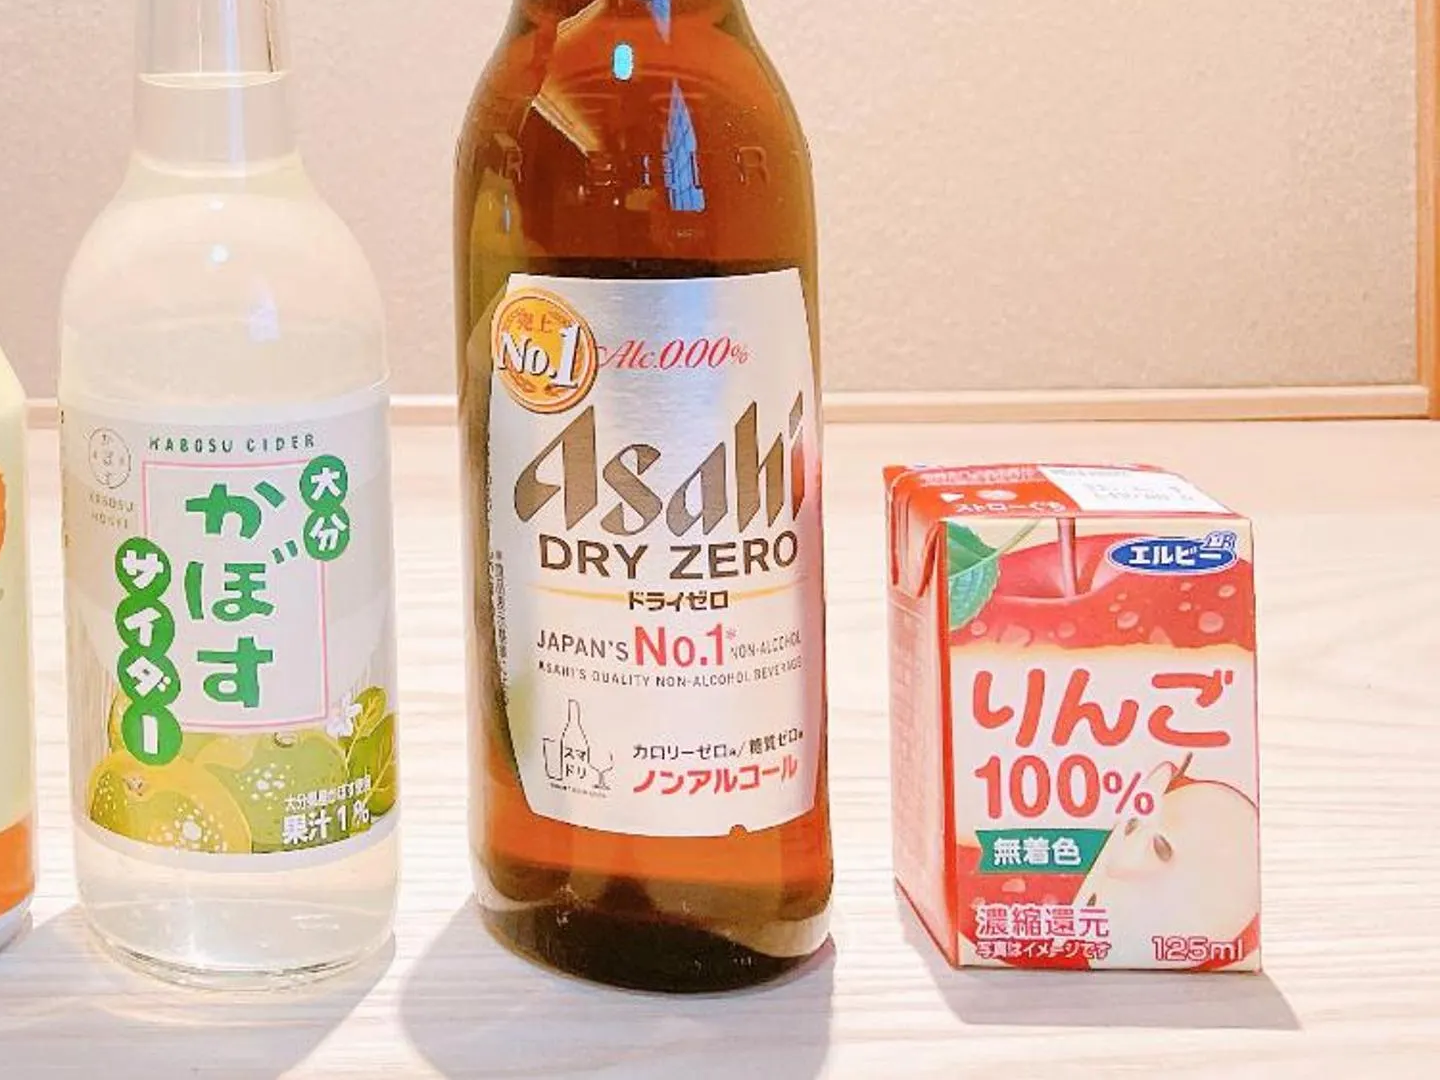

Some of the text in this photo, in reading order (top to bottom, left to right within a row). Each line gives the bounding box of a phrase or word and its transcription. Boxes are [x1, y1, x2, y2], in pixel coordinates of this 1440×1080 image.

[497, 322, 580, 389] No.1
[149, 433, 315, 453] KABOSU CIDER
[514, 391, 805, 537] Asahi
[310, 466, 346, 552] 大分
[538, 530, 798, 580] DRY ZERO
[1129, 545, 1223, 566] エルビー
[185, 482, 298, 708] かぼす
[628, 589, 729, 611] ドライゼロ
[122, 548, 171, 754] サイダー
[537, 629, 629, 662] JAPAN'S
[592, 669, 650, 687] QUALITY
[656, 669, 749, 687] NON-ALCOHOL
[972, 668, 1234, 748] りんご
[564, 747, 586, 761] スマ
[565, 764, 587, 779] ドリ
[632, 754, 798, 795] ノンアルコール
[974, 753, 1155, 819] 100%
[993, 837, 1082, 866] 無着色
[978, 907, 1110, 938] 濃縮還元
[1152, 935, 1245, 962] 125ml
